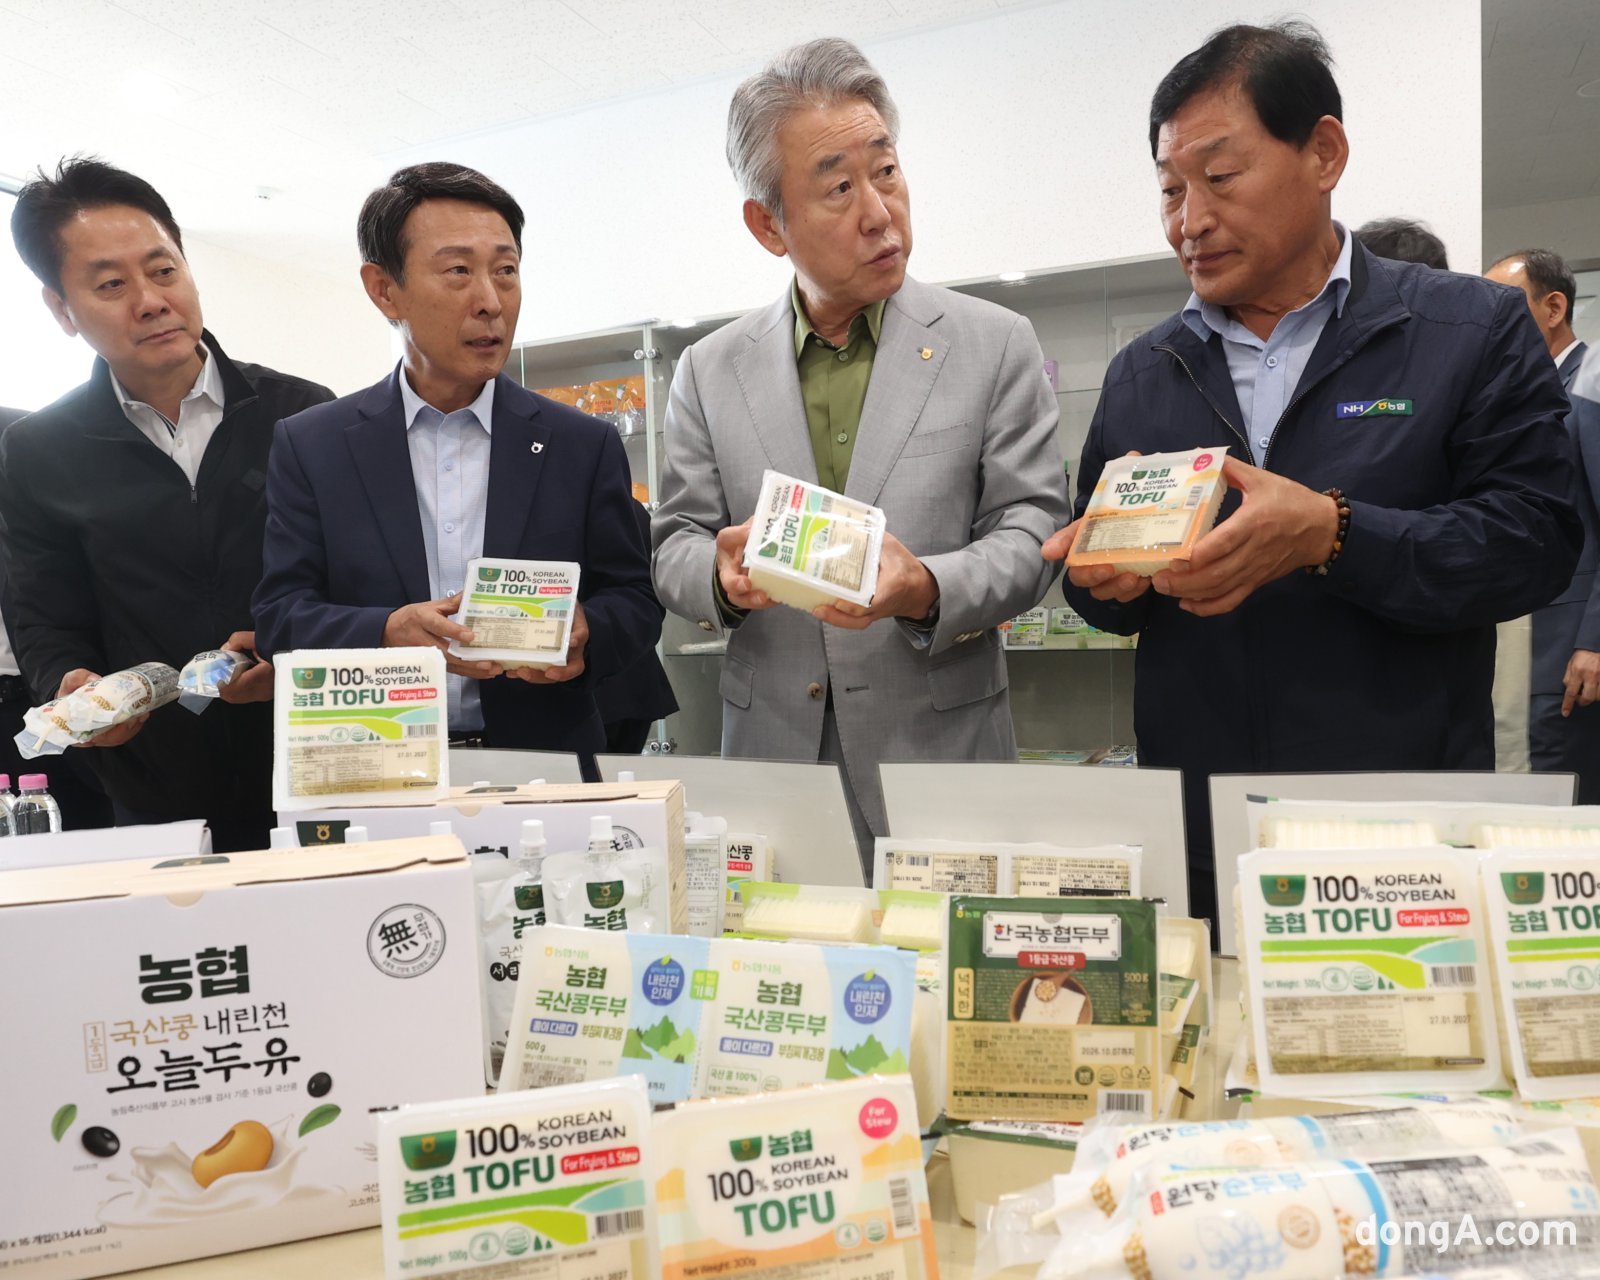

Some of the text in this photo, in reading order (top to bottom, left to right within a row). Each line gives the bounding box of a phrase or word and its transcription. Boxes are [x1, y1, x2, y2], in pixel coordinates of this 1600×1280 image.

[1343, 404, 1364, 414] NH
[1114, 482, 1141, 494] 100%
[1141, 483, 1178, 492] SOYBEAN
[1144, 478, 1176, 486] KOREAN
[1119, 490, 1166, 507] TOFU
[782, 513, 800, 544] TOFU
[504, 570, 532, 583] 100%
[475, 582, 537, 595] 농협 TOFU
[331, 667, 374, 687] 100%
[375, 665, 421, 675] KOREAN
[375, 675, 430, 686] SOYBEAN
[293, 688, 385, 706] 농협 TOFU
[727, 844, 753, 861] 산콩
[1312, 875, 1374, 903] 100%
[1375, 873, 1442, 886] KOREAN
[1551, 871, 1600, 900] 100
[1376, 889, 1456, 903] SOYBEAN
[413, 911, 433, 940] 무첨가
[1264, 907, 1393, 934] 농협 TOFU
[1400, 912, 1416, 923] For
[1416, 912, 1439, 927] Frying
[1448, 911, 1468, 923] Stew
[1508, 910, 1549, 932] 농협
[378, 919, 419, 958] 無
[993, 923, 1111, 944] 한국농협두부
[1028, 954, 1051, 966] 1등급
[139, 945, 251, 1004] 농협
[566, 965, 607, 989] 농협
[648, 973, 680, 989] 내린천
[536, 989, 627, 1017] 국산콩두부
[652, 987, 672, 1001] 인제
[757, 980, 803, 1007] 농협
[850, 989, 885, 1005] 내린천
[110, 1001, 290, 1047] 국산콩 내린천
[724, 1006, 827, 1036] 국산콩두부
[526, 1041, 540, 1050] 600
[106, 1037, 301, 1094] 오늘두유
[710, 1068, 725, 1079] 국산
[735, 1071, 758, 1082] 100%
[537, 1109, 613, 1132] KOREAN
[868, 1105, 886, 1118] For
[865, 1116, 893, 1129] Stew
[465, 1124, 536, 1158] 100%
[538, 1126, 627, 1150] SOYBEAN
[767, 1129, 813, 1158] 농협
[563, 1158, 578, 1171] For
[579, 1155, 607, 1173] Frying
[617, 1150, 639, 1163] Stew
[771, 1155, 836, 1175] KOREAN
[404, 1154, 555, 1205] 농협 TOFU
[707, 1168, 768, 1202] 100%
[773, 1169, 849, 1192] SOYBEAN
[734, 1190, 836, 1238] TOFU
[400, 1258, 414, 1271] Net
[448, 1250, 469, 1264] 500g
[683, 1265, 698, 1278] Net
[732, 1256, 757, 1269] 300g
